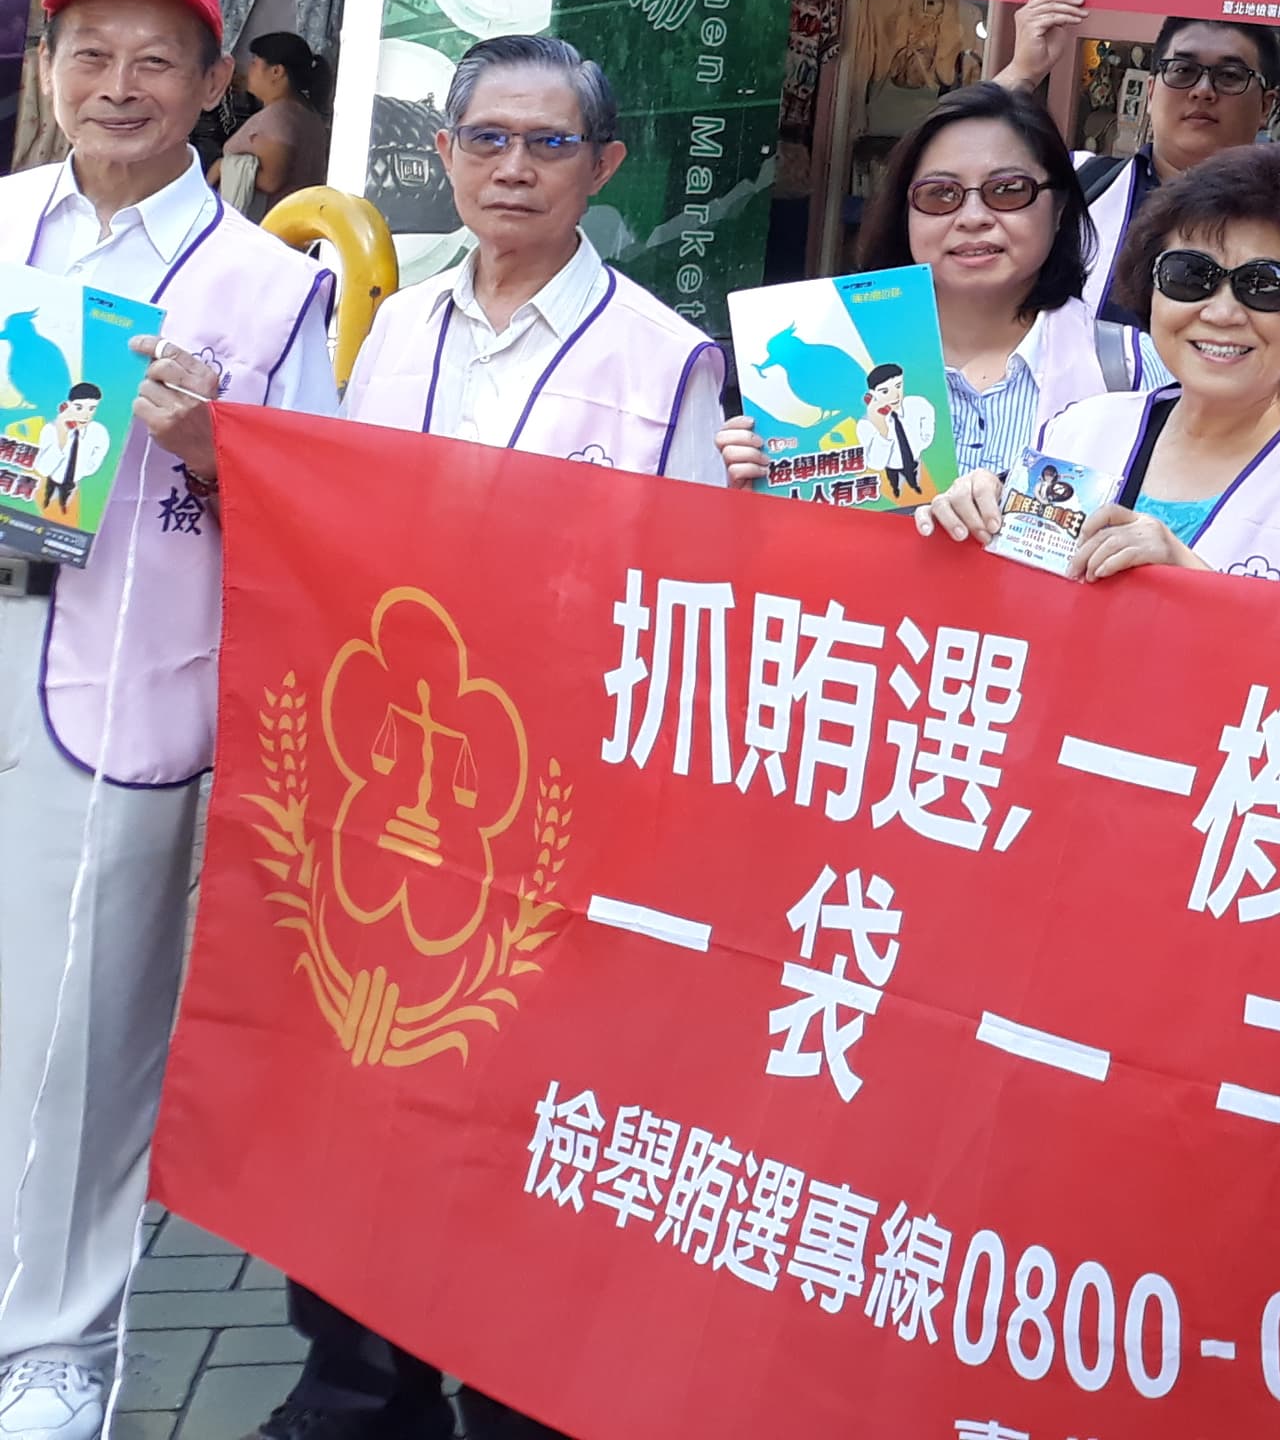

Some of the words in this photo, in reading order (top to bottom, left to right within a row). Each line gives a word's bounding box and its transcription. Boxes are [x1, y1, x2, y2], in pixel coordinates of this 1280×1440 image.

[674, 115, 727, 317] Market
[768, 446, 865, 486] 檢舉賄選
